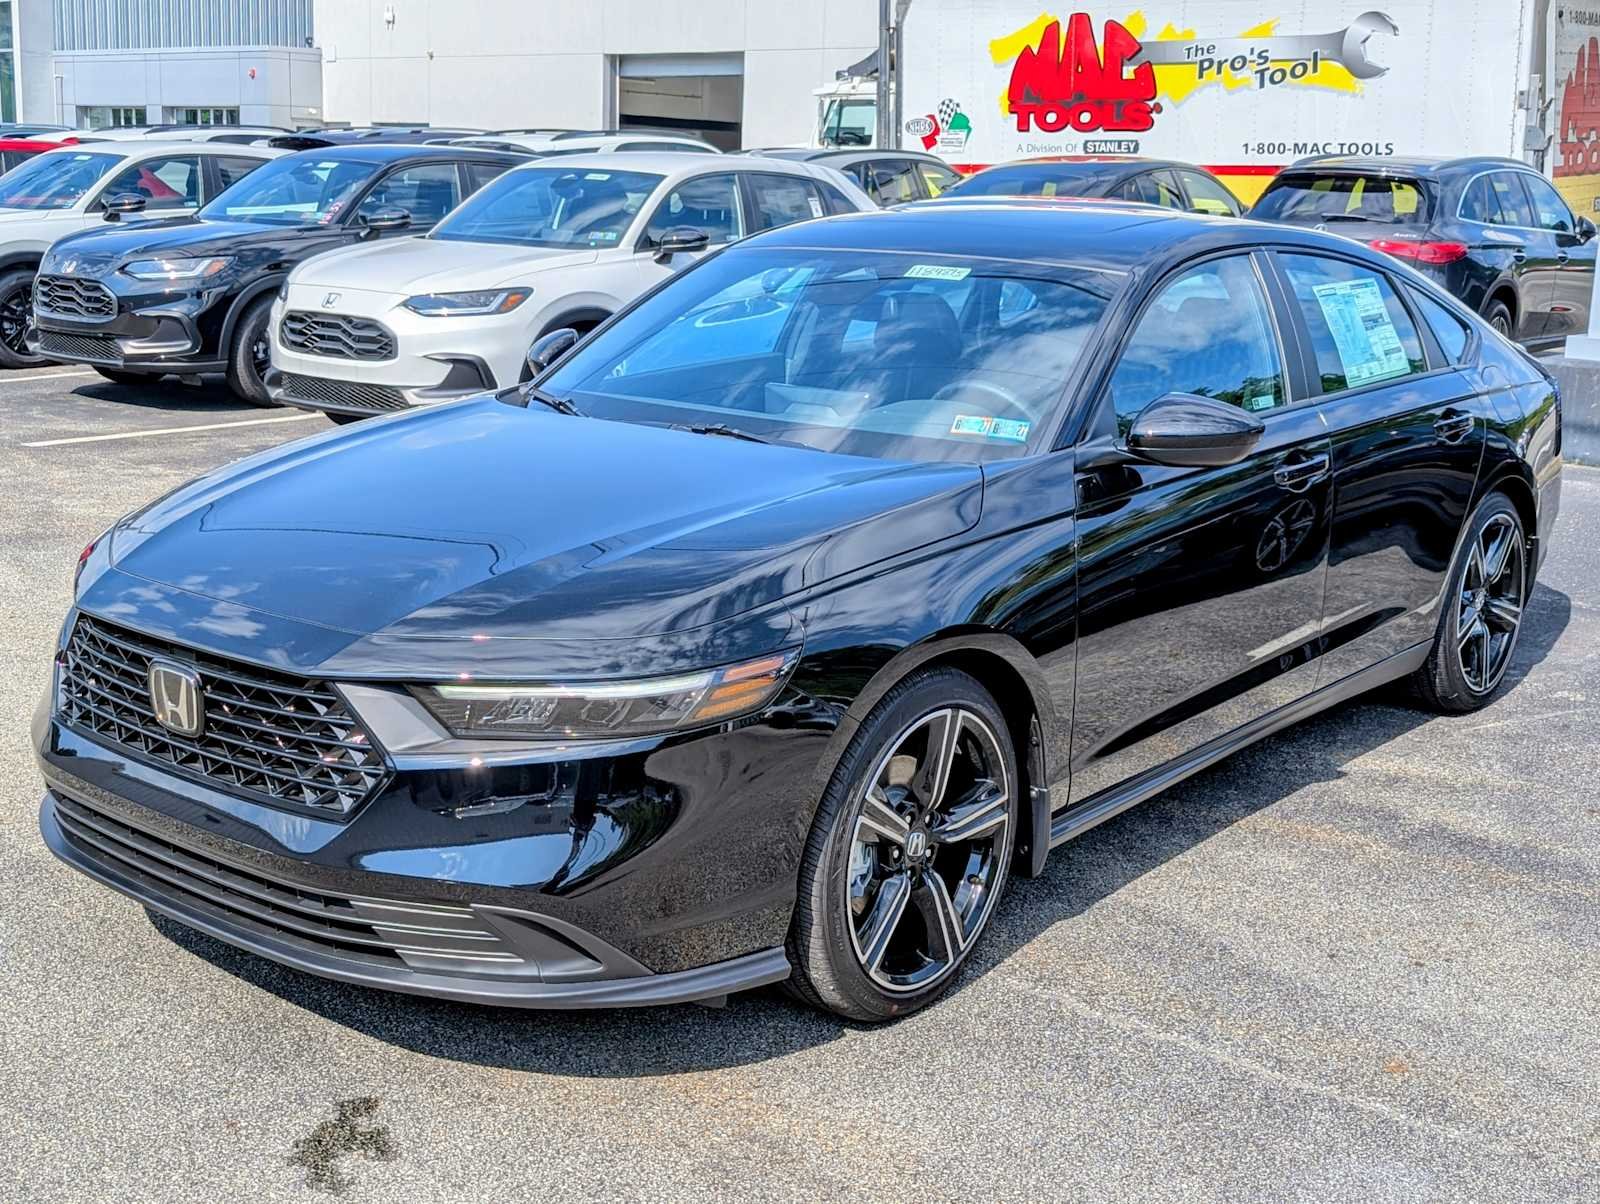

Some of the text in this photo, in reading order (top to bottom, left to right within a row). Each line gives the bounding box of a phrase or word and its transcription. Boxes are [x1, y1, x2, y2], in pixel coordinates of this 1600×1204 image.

[1569, 10, 1600, 26] 1-800-MA
[1008, 12, 1157, 101] MAC
[1184, 44, 1216, 60] The
[1198, 47, 1270, 80] Pro's
[1254, 51, 1319, 90] Tool
[1008, 101, 1154, 133] TOOLS
[1016, 141, 1136, 153] A Division Of STANLEY
[1242, 142, 1394, 156] 1-800-MAC TOOLS
